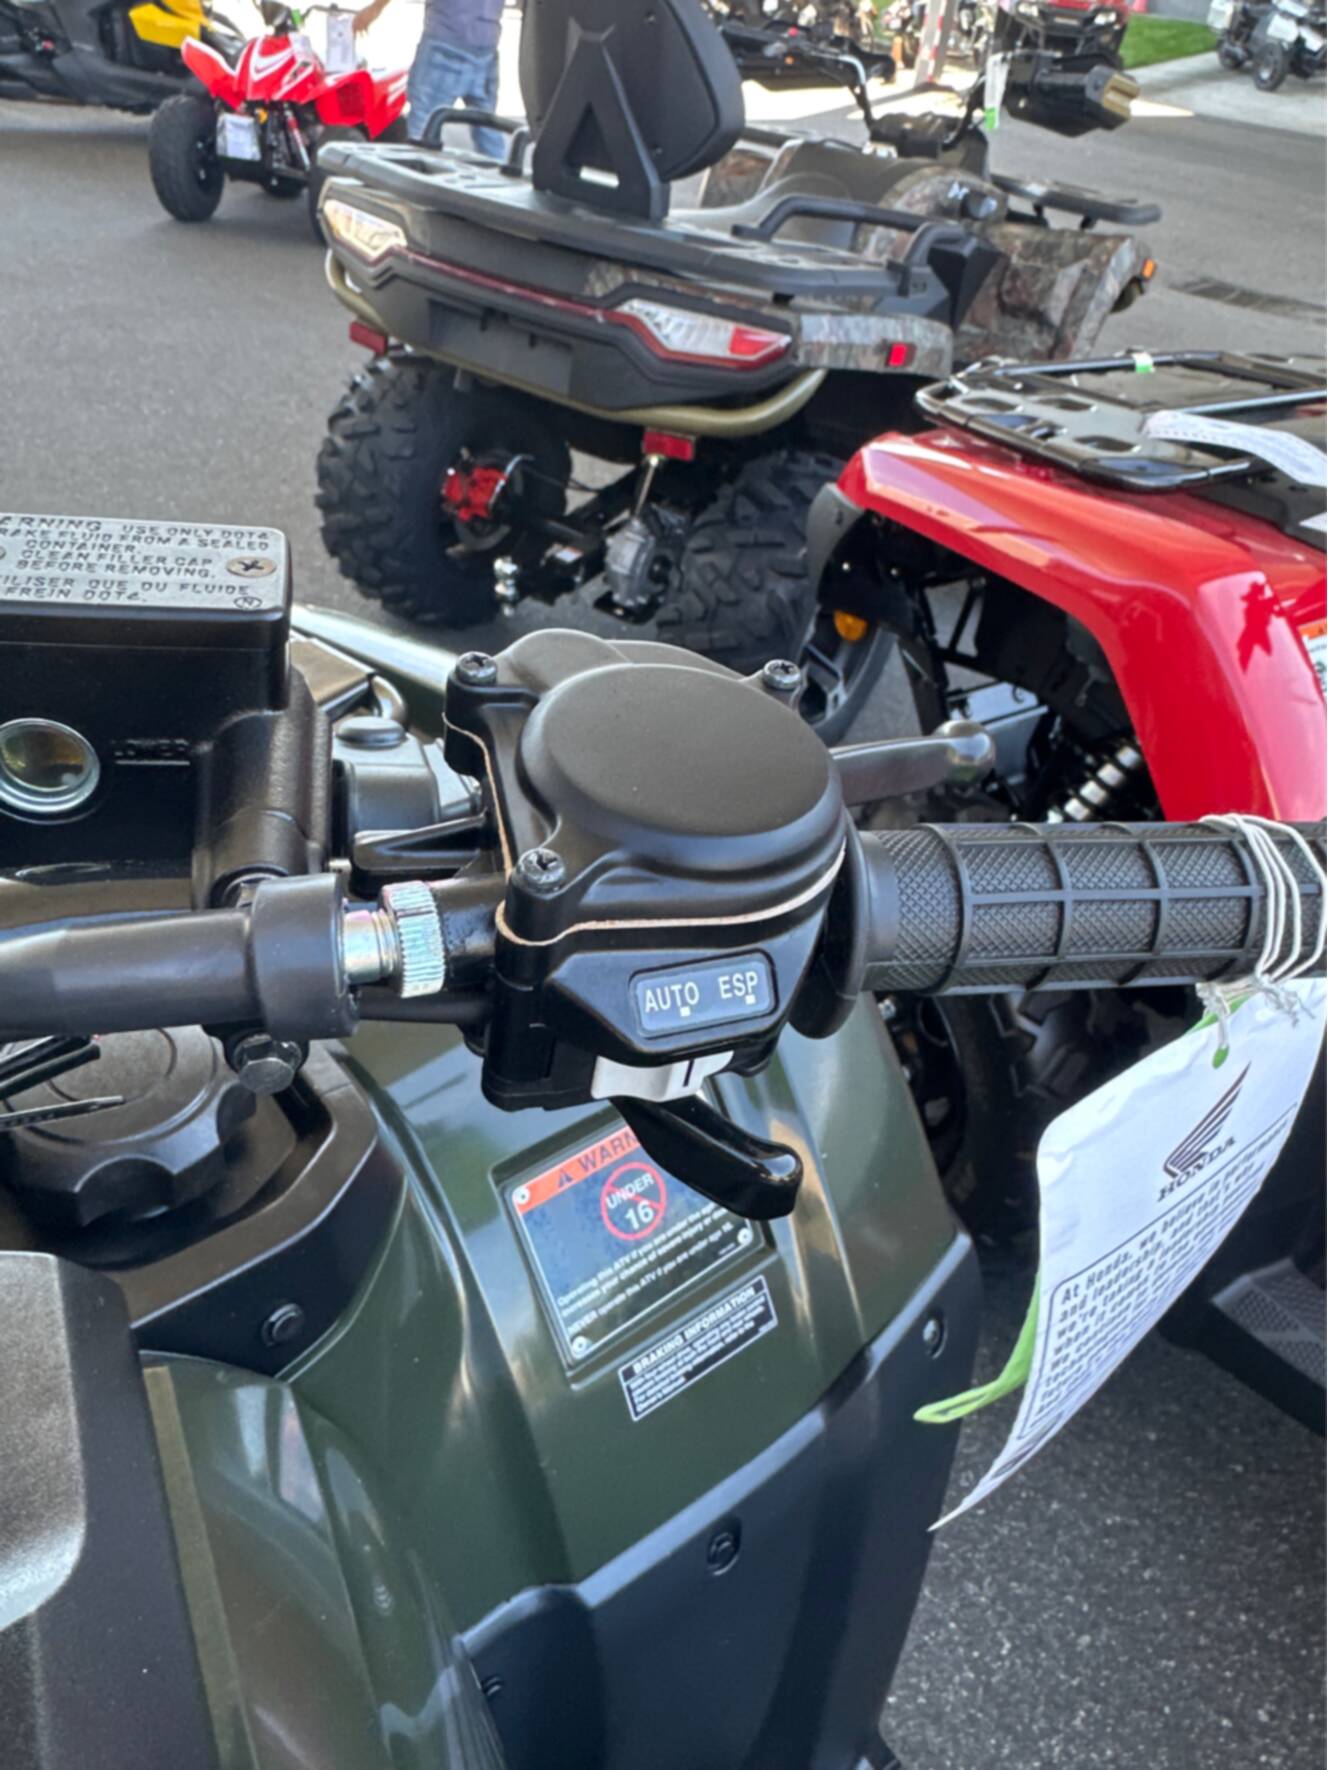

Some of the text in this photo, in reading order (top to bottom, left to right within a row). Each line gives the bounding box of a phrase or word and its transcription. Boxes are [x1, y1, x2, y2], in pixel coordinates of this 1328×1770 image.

[0, 516, 102, 532] ARNING
[122, 525, 158, 537] USE
[167, 527, 213, 538] ONLY
[0, 527, 268, 551] RAKE FLUID FROM A SEALED
[17, 560, 216, 579] BEFORE REMOVING.
[22, 550, 214, 567] CLEAN FILLER CAP
[5, 587, 71, 599] FREIN
[140, 581, 168, 592] DU
[179, 583, 251, 596] FLUIDE
[645, 971, 758, 1013] AUTO ESP
[1158, 1136, 1236, 1202] HONDA
[606, 1173, 656, 1210] UNDER
[625, 1199, 655, 1231] 16
[1061, 1284, 1079, 1305] At
[632, 1333, 684, 1374] BRAKING
[683, 1286, 754, 1342] INFORMATION
